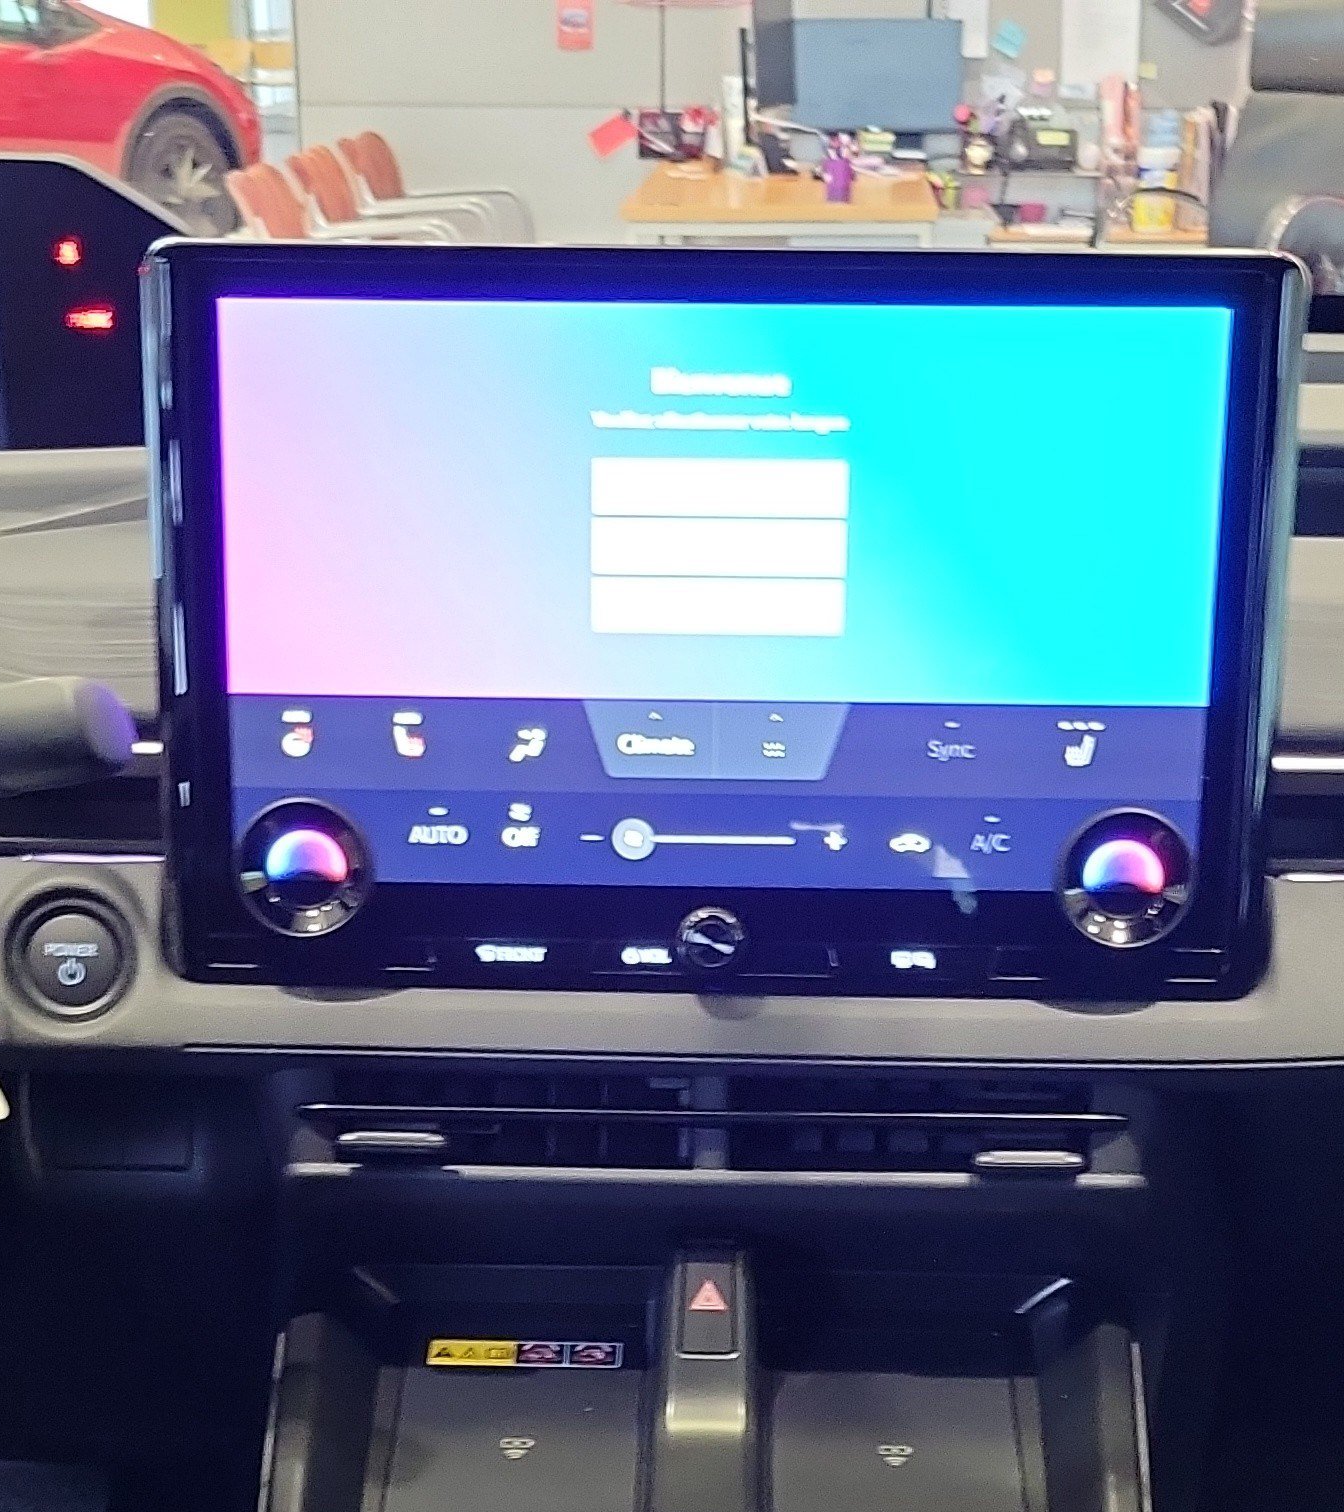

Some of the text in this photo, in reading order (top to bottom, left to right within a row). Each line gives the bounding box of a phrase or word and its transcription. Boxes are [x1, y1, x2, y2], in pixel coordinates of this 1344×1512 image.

[927, 740, 976, 761] Sync
[408, 824, 469, 845] AUTO
[970, 833, 1011, 853] A/C
